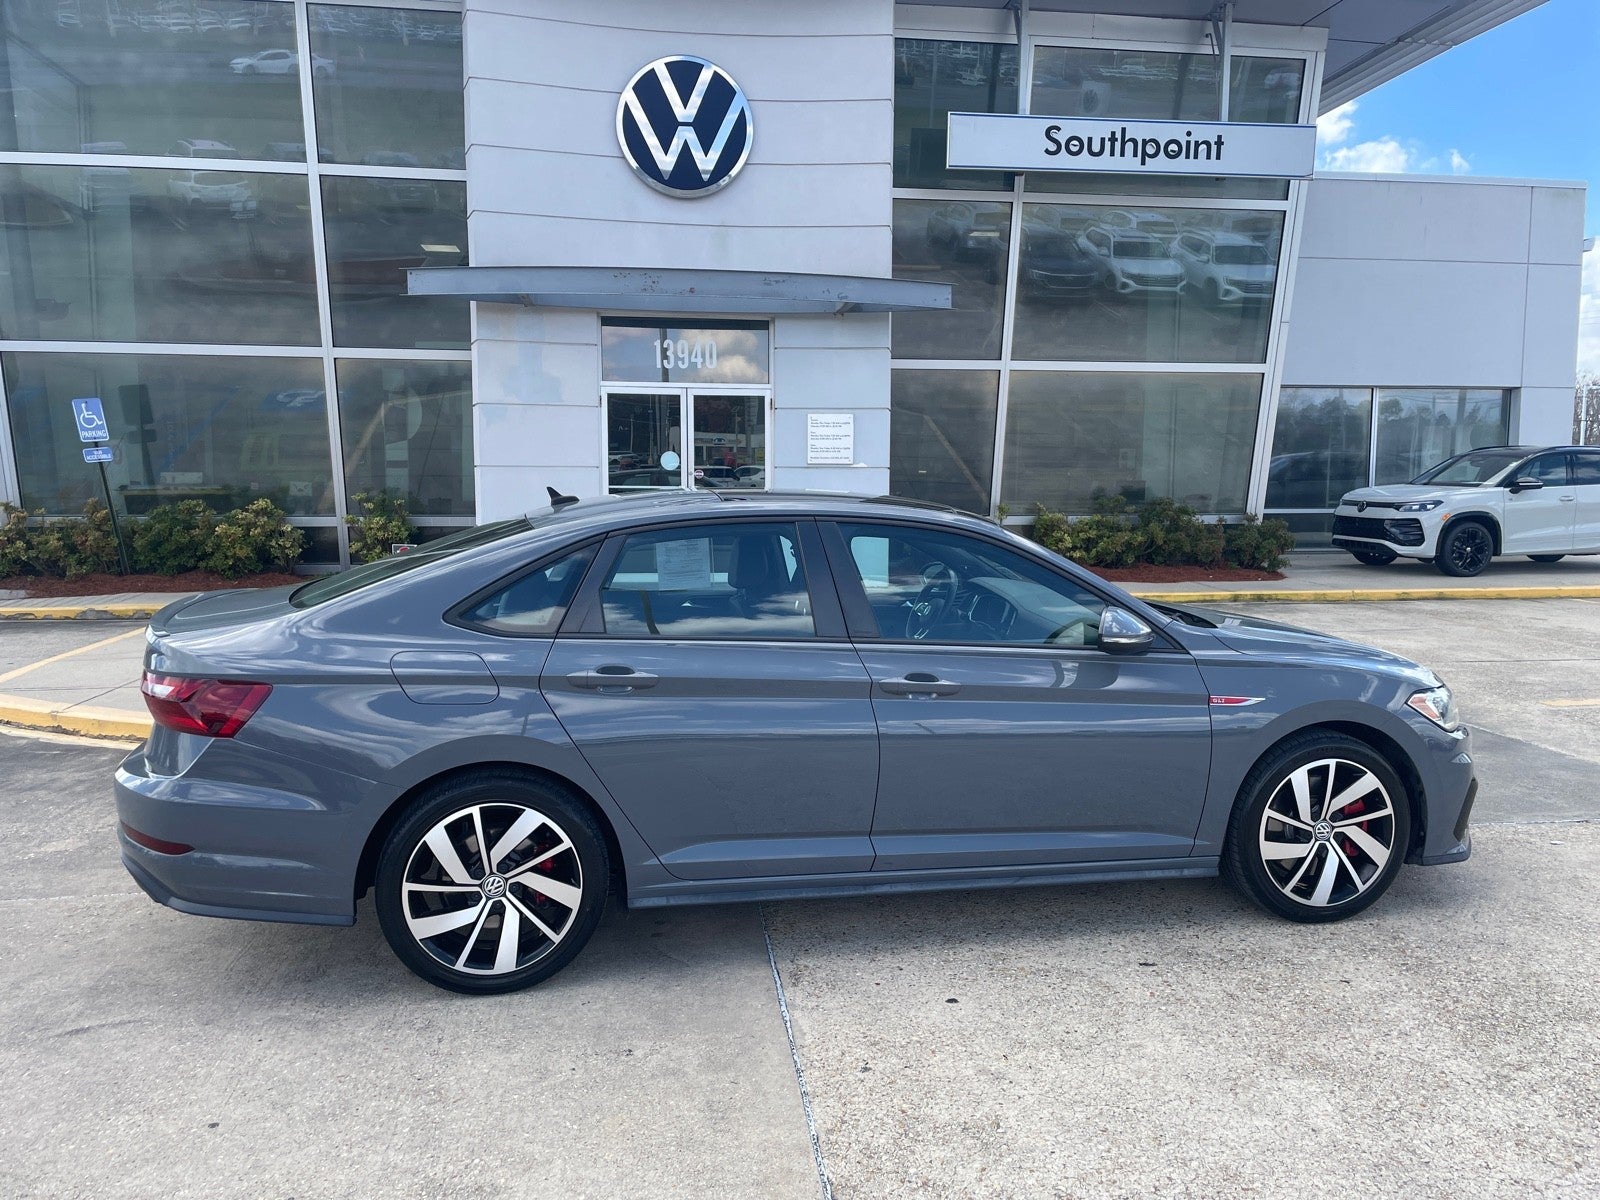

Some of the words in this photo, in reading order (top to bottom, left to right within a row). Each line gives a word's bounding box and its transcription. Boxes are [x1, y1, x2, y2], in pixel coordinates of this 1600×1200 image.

[621, 60, 747, 184] VW
[1043, 125, 1225, 166] Southpoint
[653, 338, 718, 370] 13940
[81, 430, 107, 438] PARKING
[483, 876, 506, 897] VW
